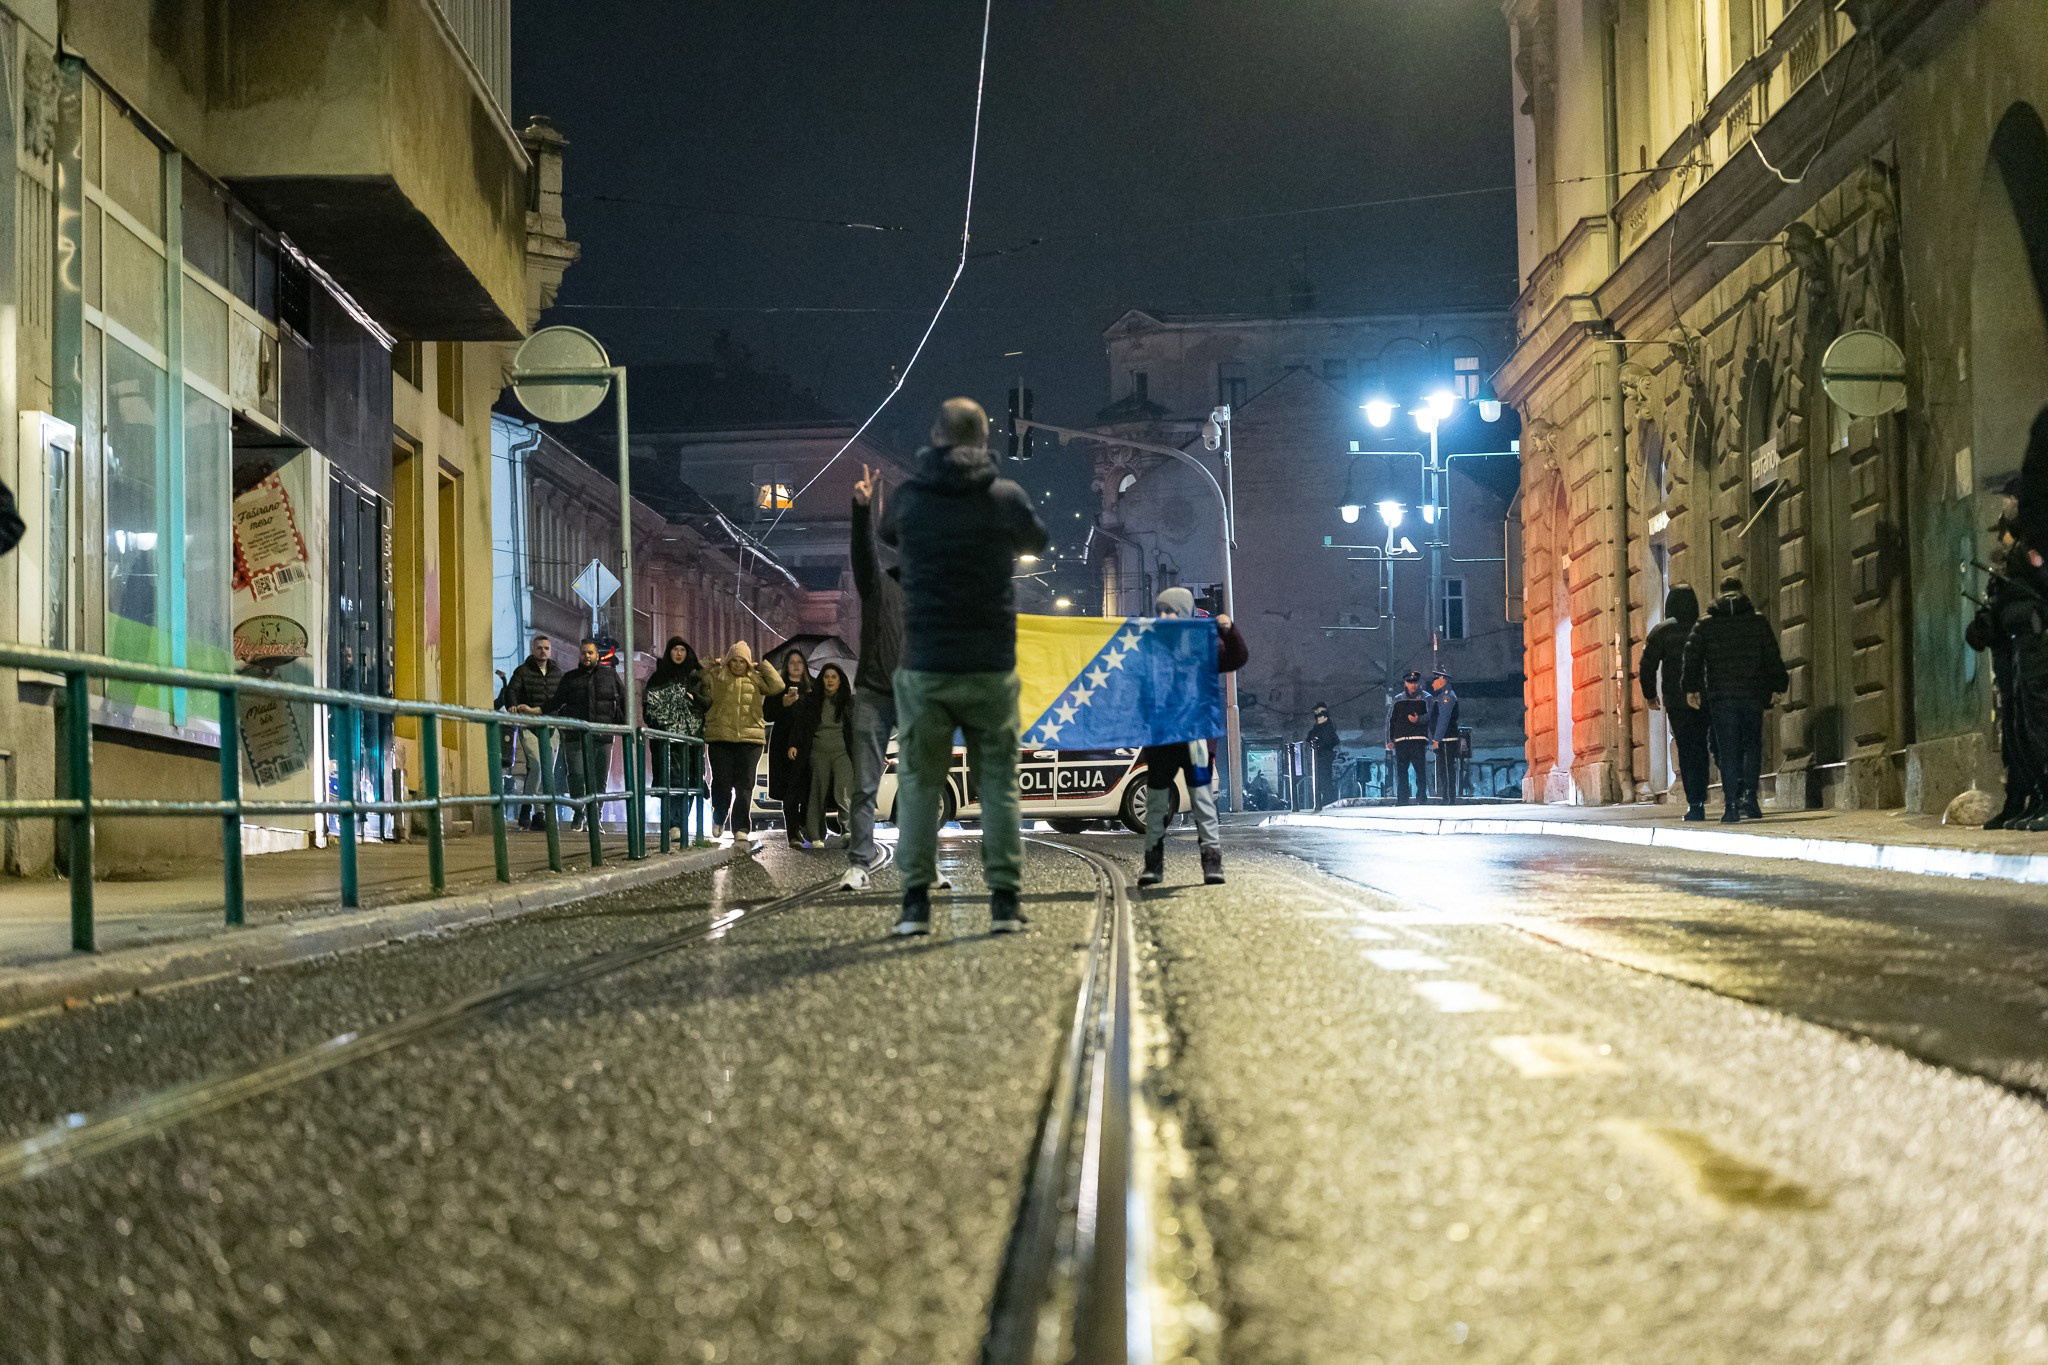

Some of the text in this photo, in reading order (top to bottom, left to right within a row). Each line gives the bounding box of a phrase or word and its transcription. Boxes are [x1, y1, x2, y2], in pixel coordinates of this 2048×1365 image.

[237, 502, 280, 525] Faširano
[250, 517, 273, 530] meso
[245, 700, 277, 720] Mladi
[1019, 770, 1106, 790] OLICIJA
